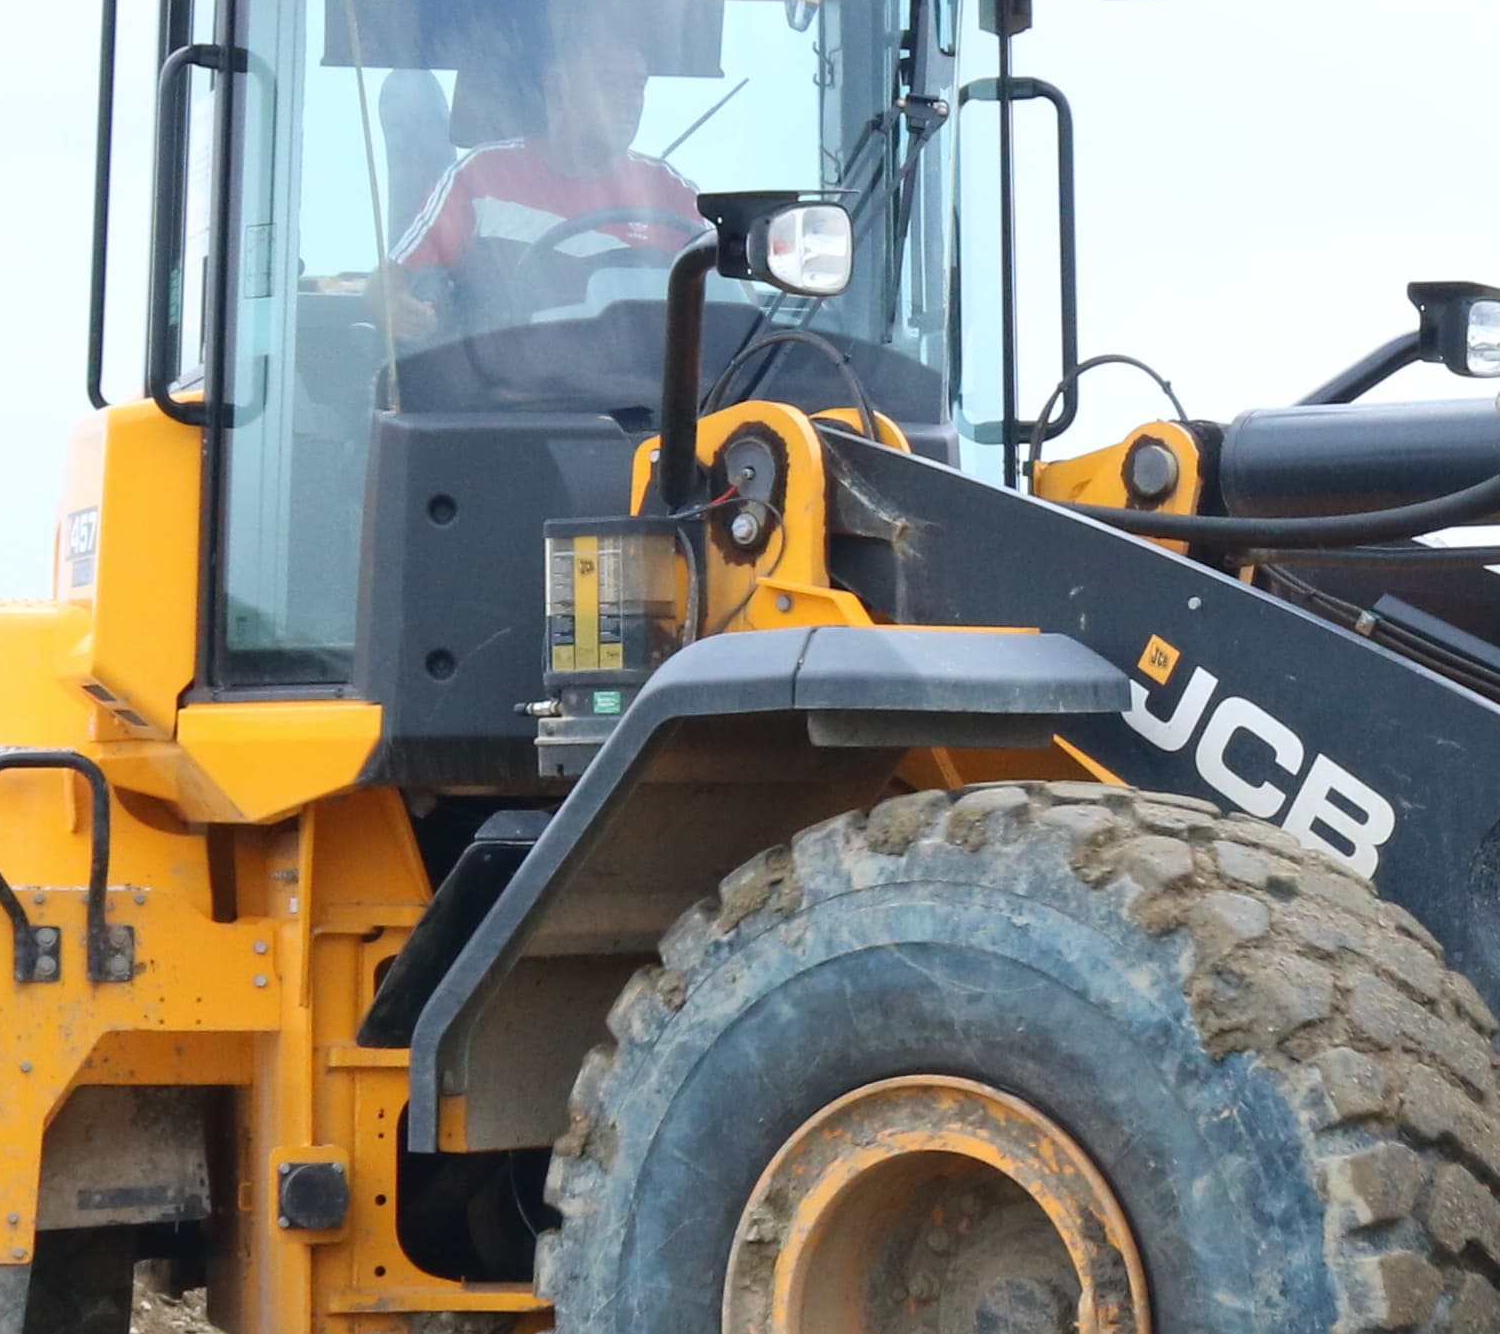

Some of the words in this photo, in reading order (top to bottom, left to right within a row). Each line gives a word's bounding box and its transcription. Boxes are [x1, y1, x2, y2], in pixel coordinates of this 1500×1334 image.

[70, 511, 97, 554] 457
[1150, 646, 1169, 668] JCB
[1121, 666, 1396, 880] JCB
